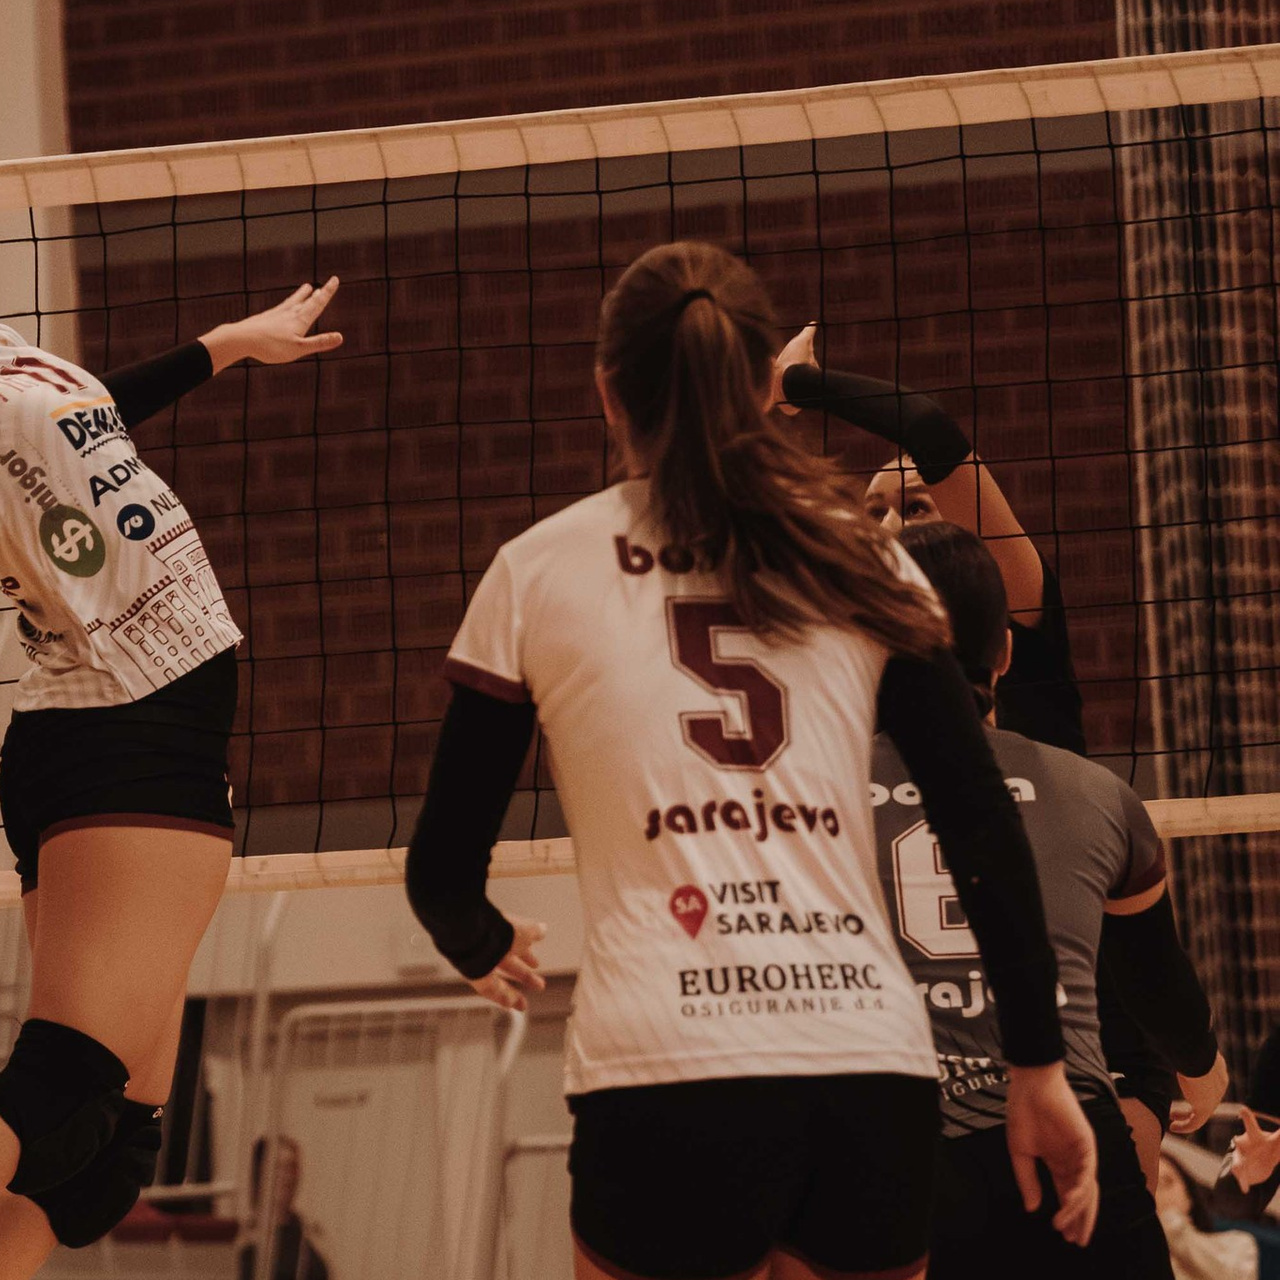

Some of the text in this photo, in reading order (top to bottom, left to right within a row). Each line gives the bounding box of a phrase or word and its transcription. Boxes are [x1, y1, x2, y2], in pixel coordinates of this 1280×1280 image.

[664, 595, 792, 774] 5
[644, 788, 841, 840] sarajevo
[710, 880, 782, 906] VISIT
[716, 911, 866, 937] SARAJEVO
[678, 963, 884, 998] EUROHERC
[680, 997, 845, 1018] OSIGURANJE
